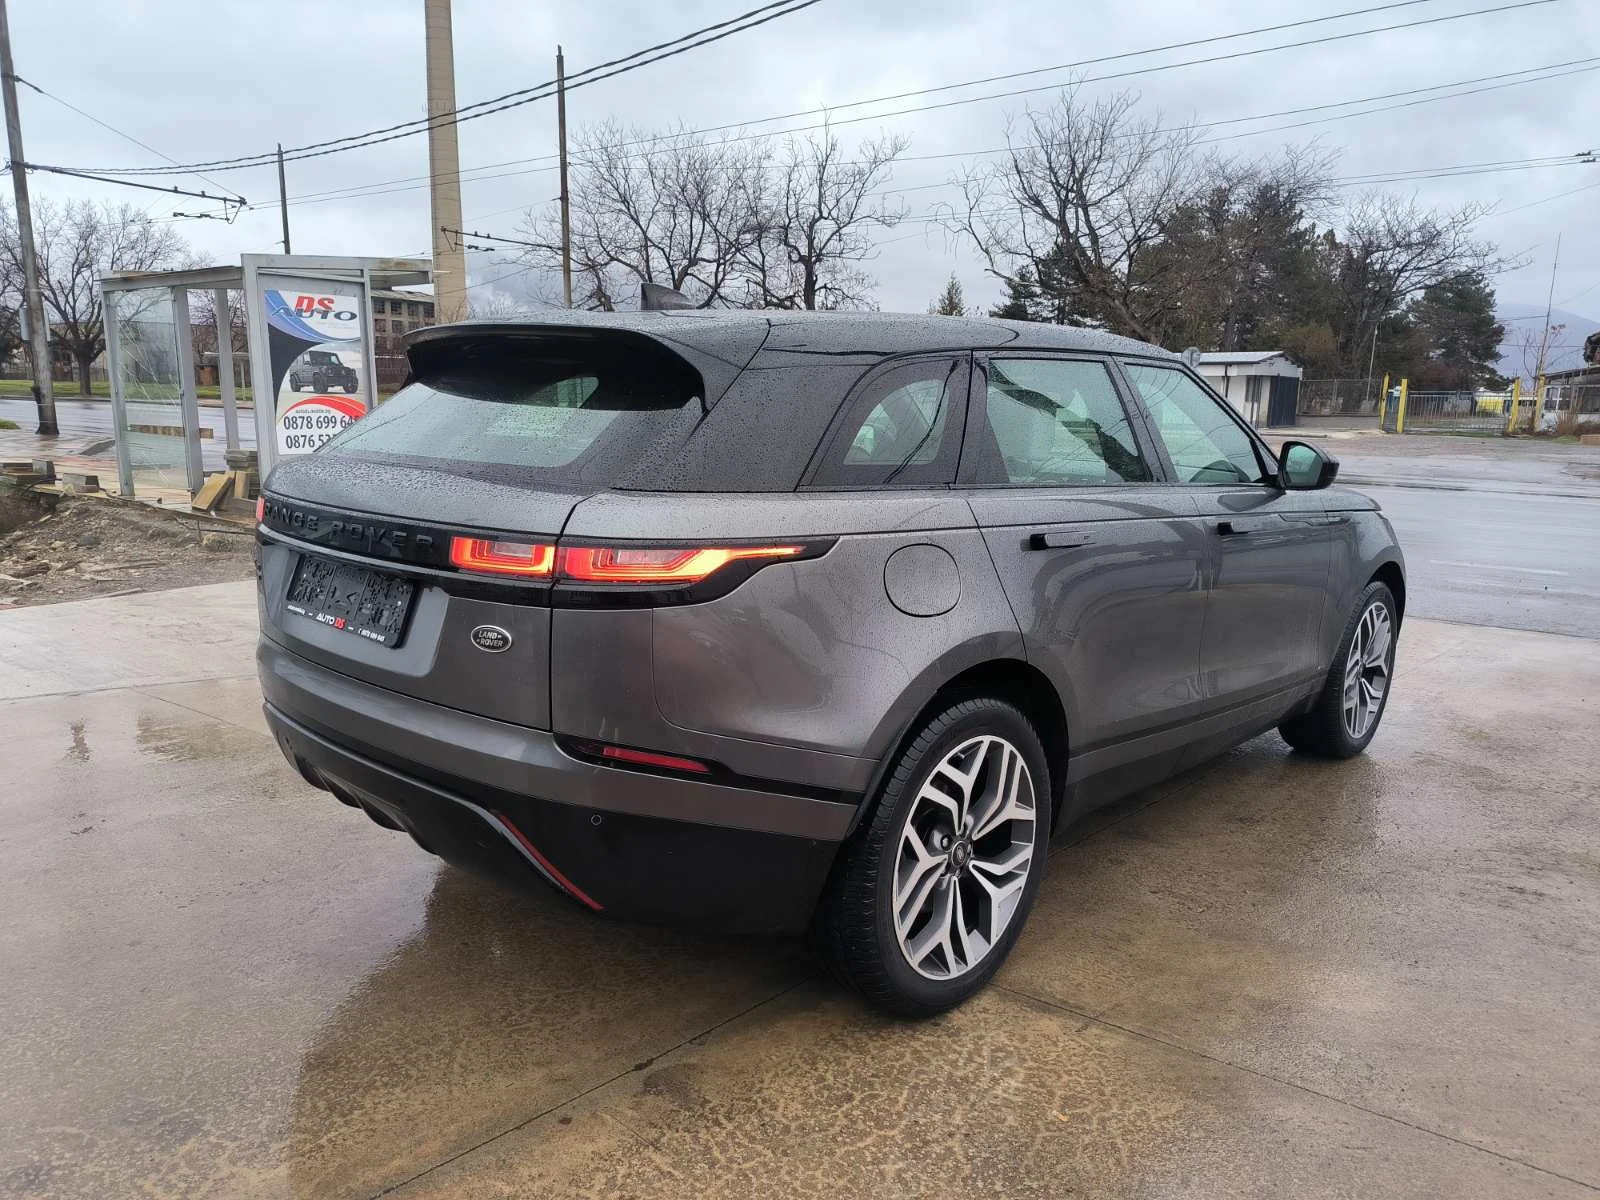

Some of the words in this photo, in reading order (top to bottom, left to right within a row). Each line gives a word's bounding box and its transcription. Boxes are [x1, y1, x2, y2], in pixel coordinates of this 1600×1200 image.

[295, 295, 335, 312] DS
[272, 306, 358, 321] AUTO
[283, 415, 313, 430] 0878
[315, 415, 337, 429] 699
[286, 434, 315, 449] 0876
[264, 502, 319, 532] RANGE
[328, 519, 433, 548] ROVER
[316, 613, 335, 625] AUTO
[334, 617, 347, 630] DS
[479, 631, 498, 639] LAND
[480, 638, 503, 646] ROVER
